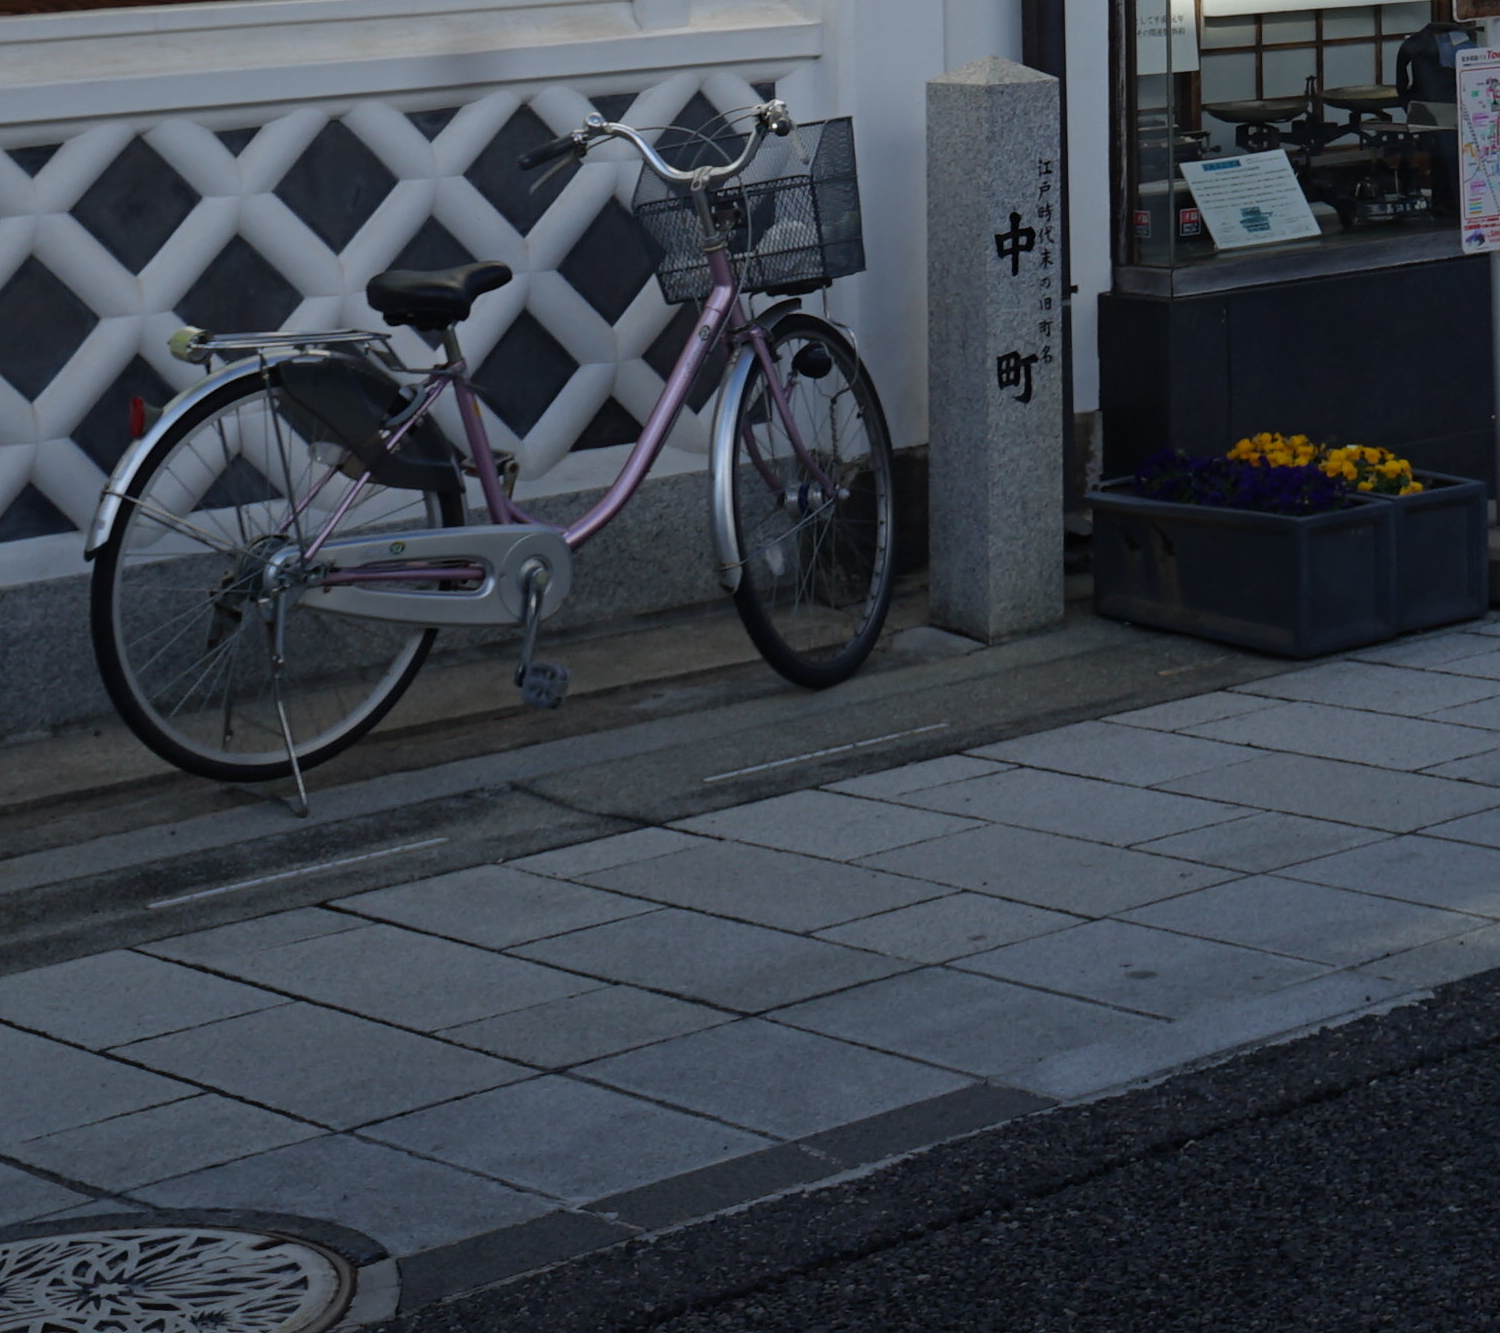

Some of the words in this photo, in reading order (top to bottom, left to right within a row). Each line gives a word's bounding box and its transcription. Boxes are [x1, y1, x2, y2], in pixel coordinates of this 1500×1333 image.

[994, 211, 1038, 404] 中町
[1037, 159, 1054, 365] 江戸時代末の旧町名
